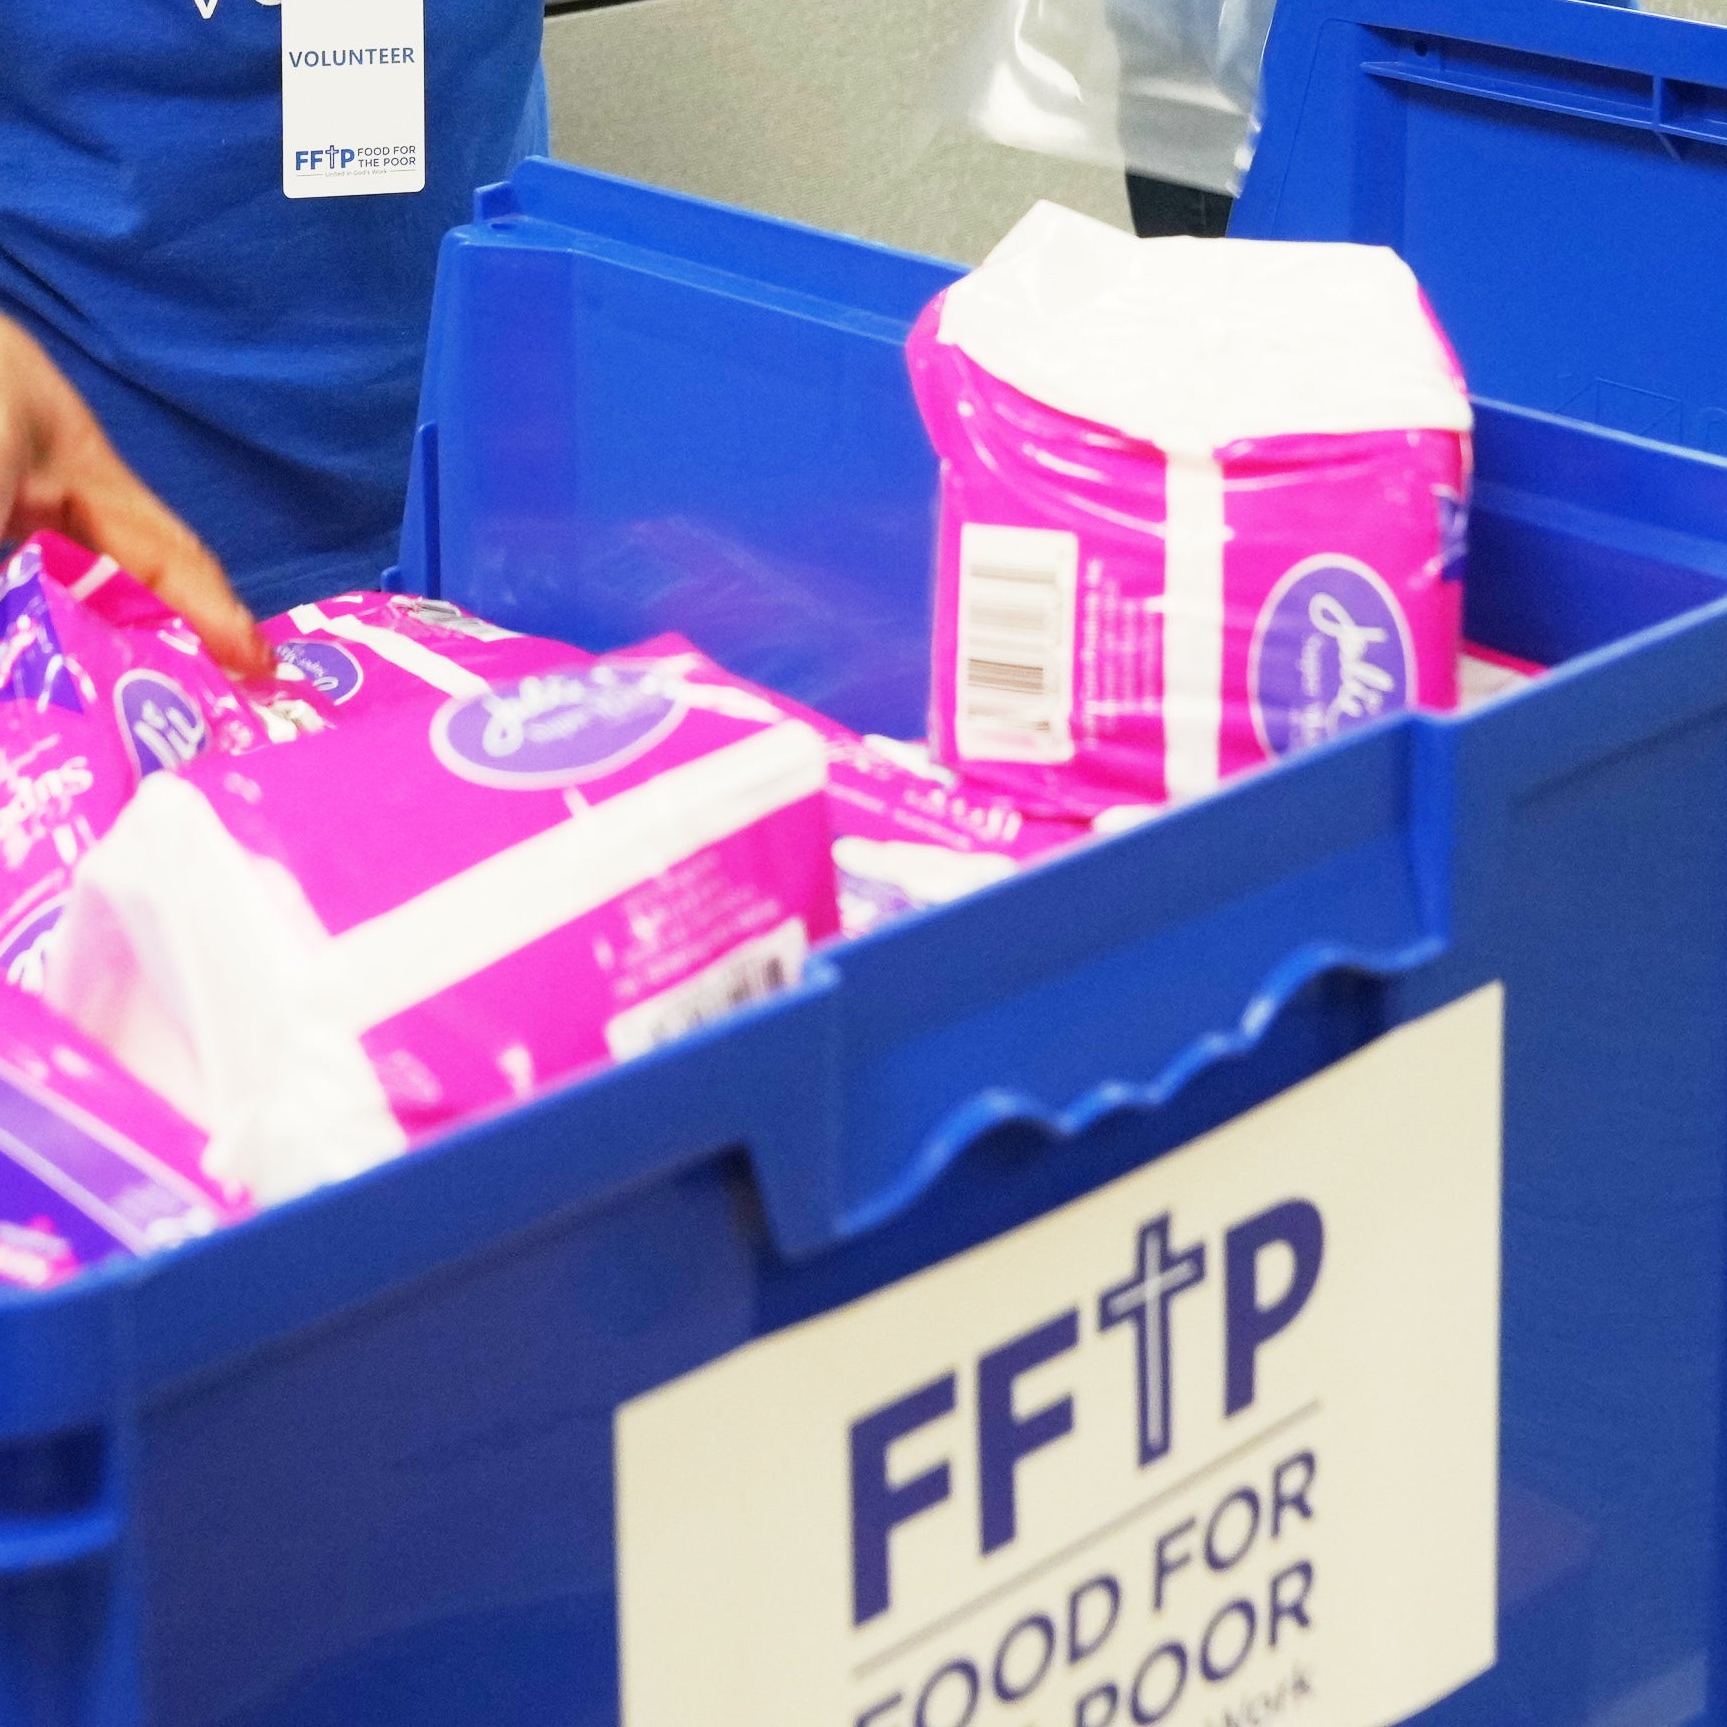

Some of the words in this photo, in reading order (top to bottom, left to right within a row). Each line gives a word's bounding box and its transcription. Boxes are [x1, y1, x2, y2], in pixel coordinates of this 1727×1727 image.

[289, 47, 415, 68] VOLUNTEER
[357, 146, 390, 157] FOOD
[393, 145, 416, 155] FOR
[358, 159, 380, 168] THE
[383, 156, 416, 167] POOR
[1153, 1448, 1316, 1613] FOR
